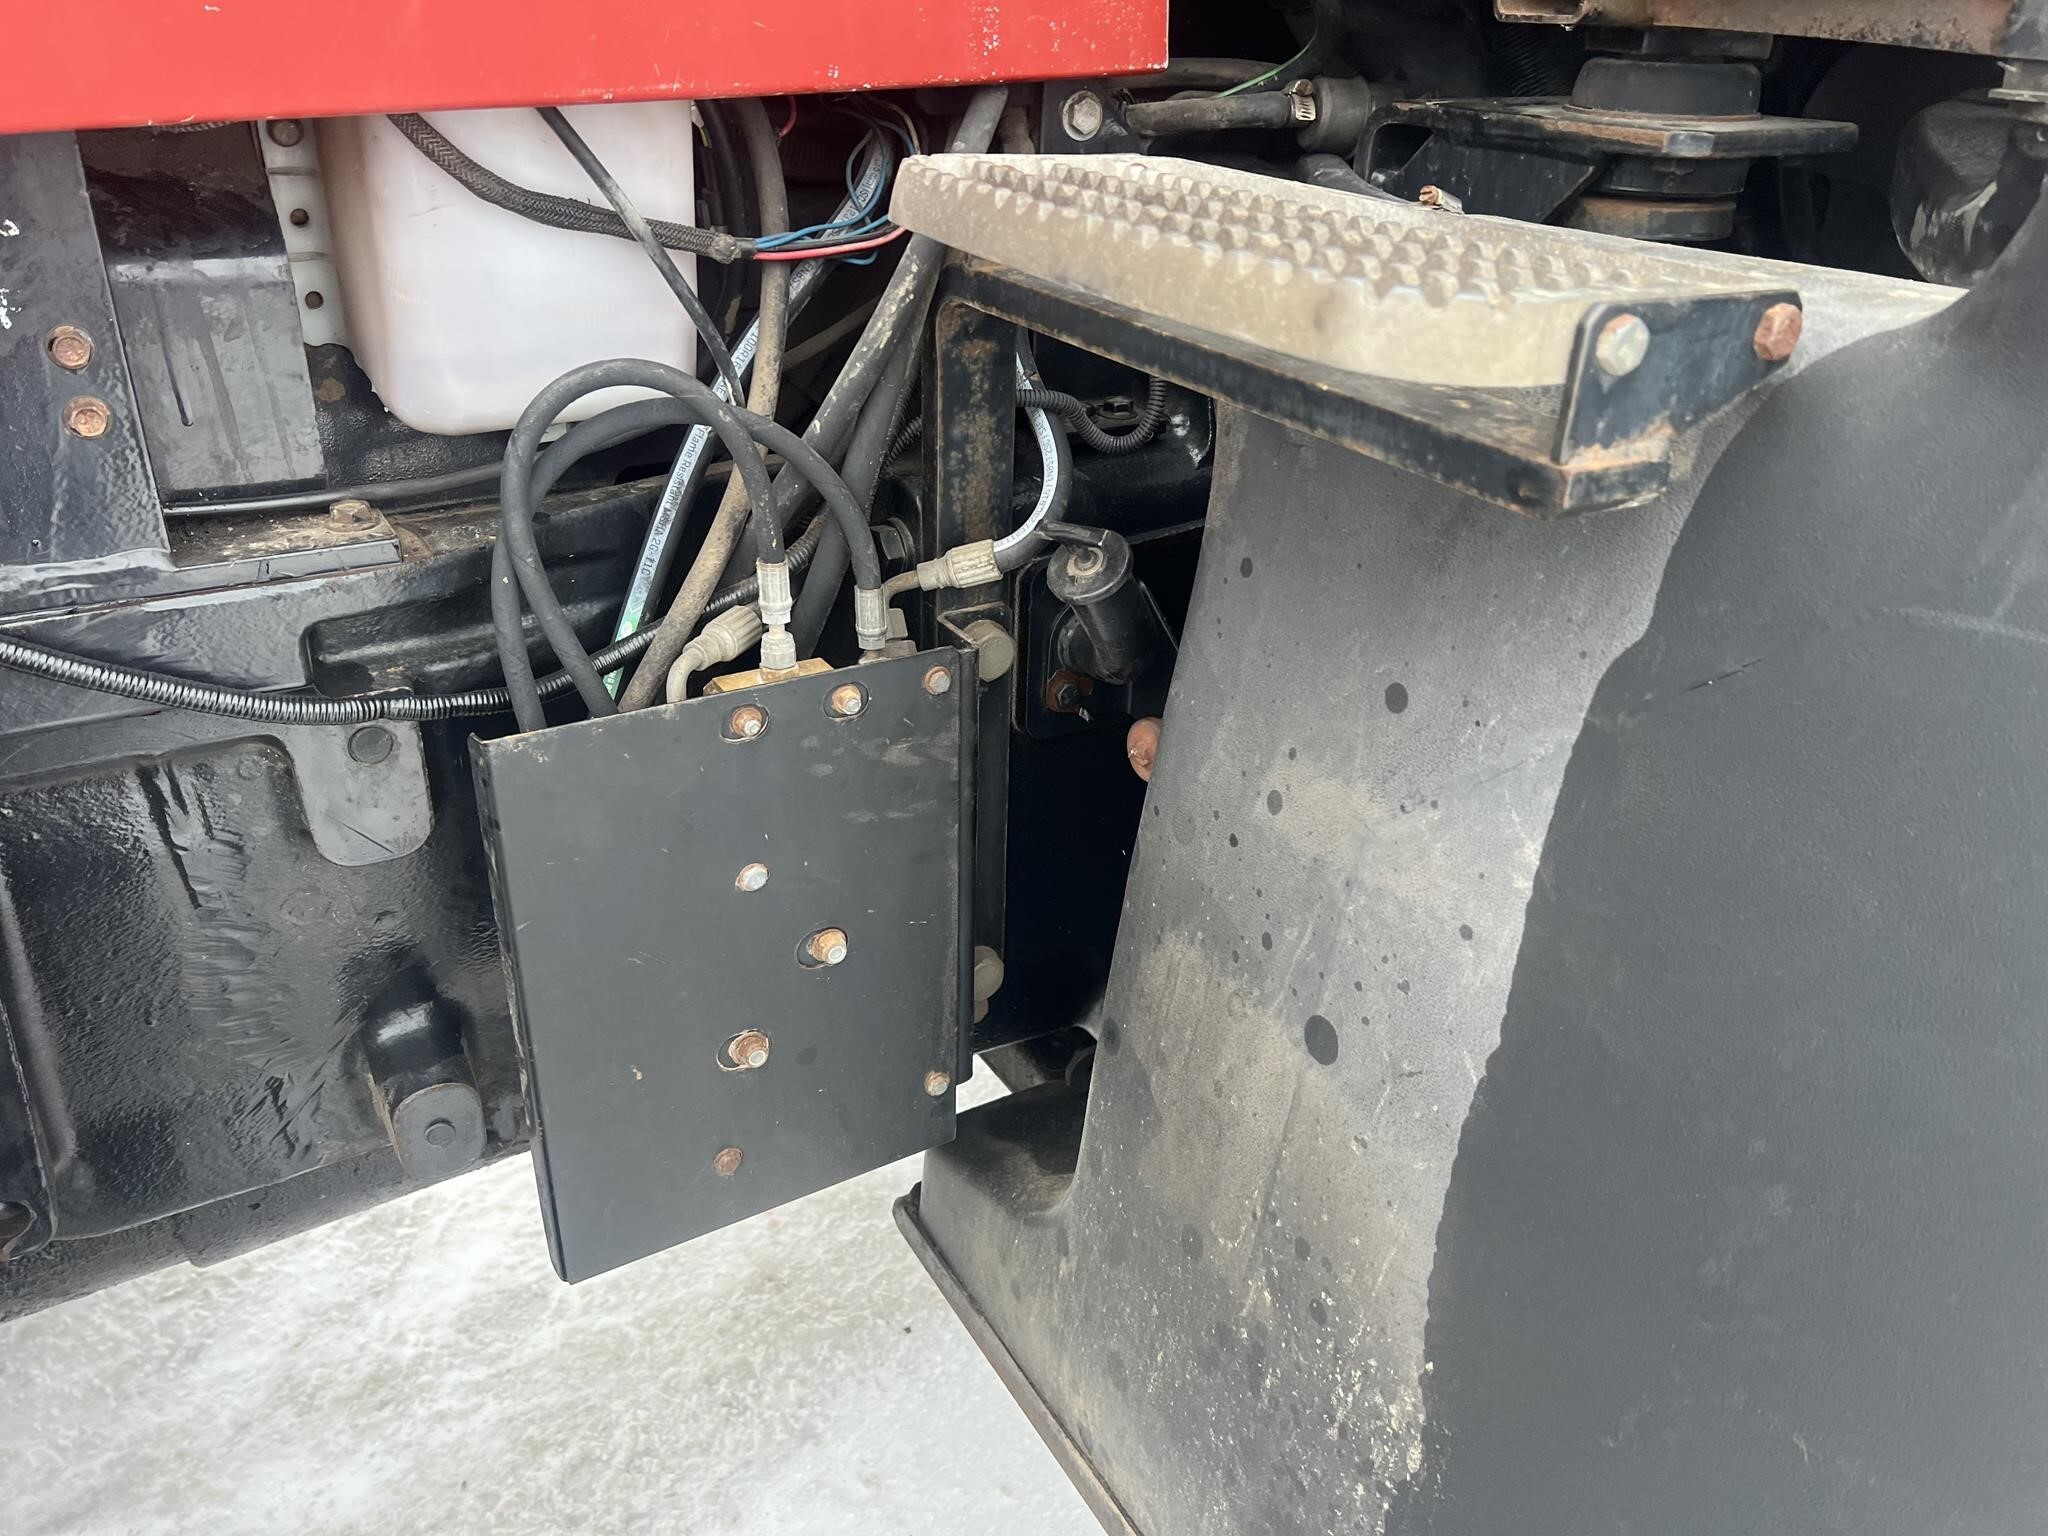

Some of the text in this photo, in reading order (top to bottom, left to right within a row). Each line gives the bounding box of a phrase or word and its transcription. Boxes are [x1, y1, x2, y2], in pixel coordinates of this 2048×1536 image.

[682, 425, 706, 461] Flame
[664, 457, 692, 507] Resistant
[651, 505, 673, 538] MSHA
